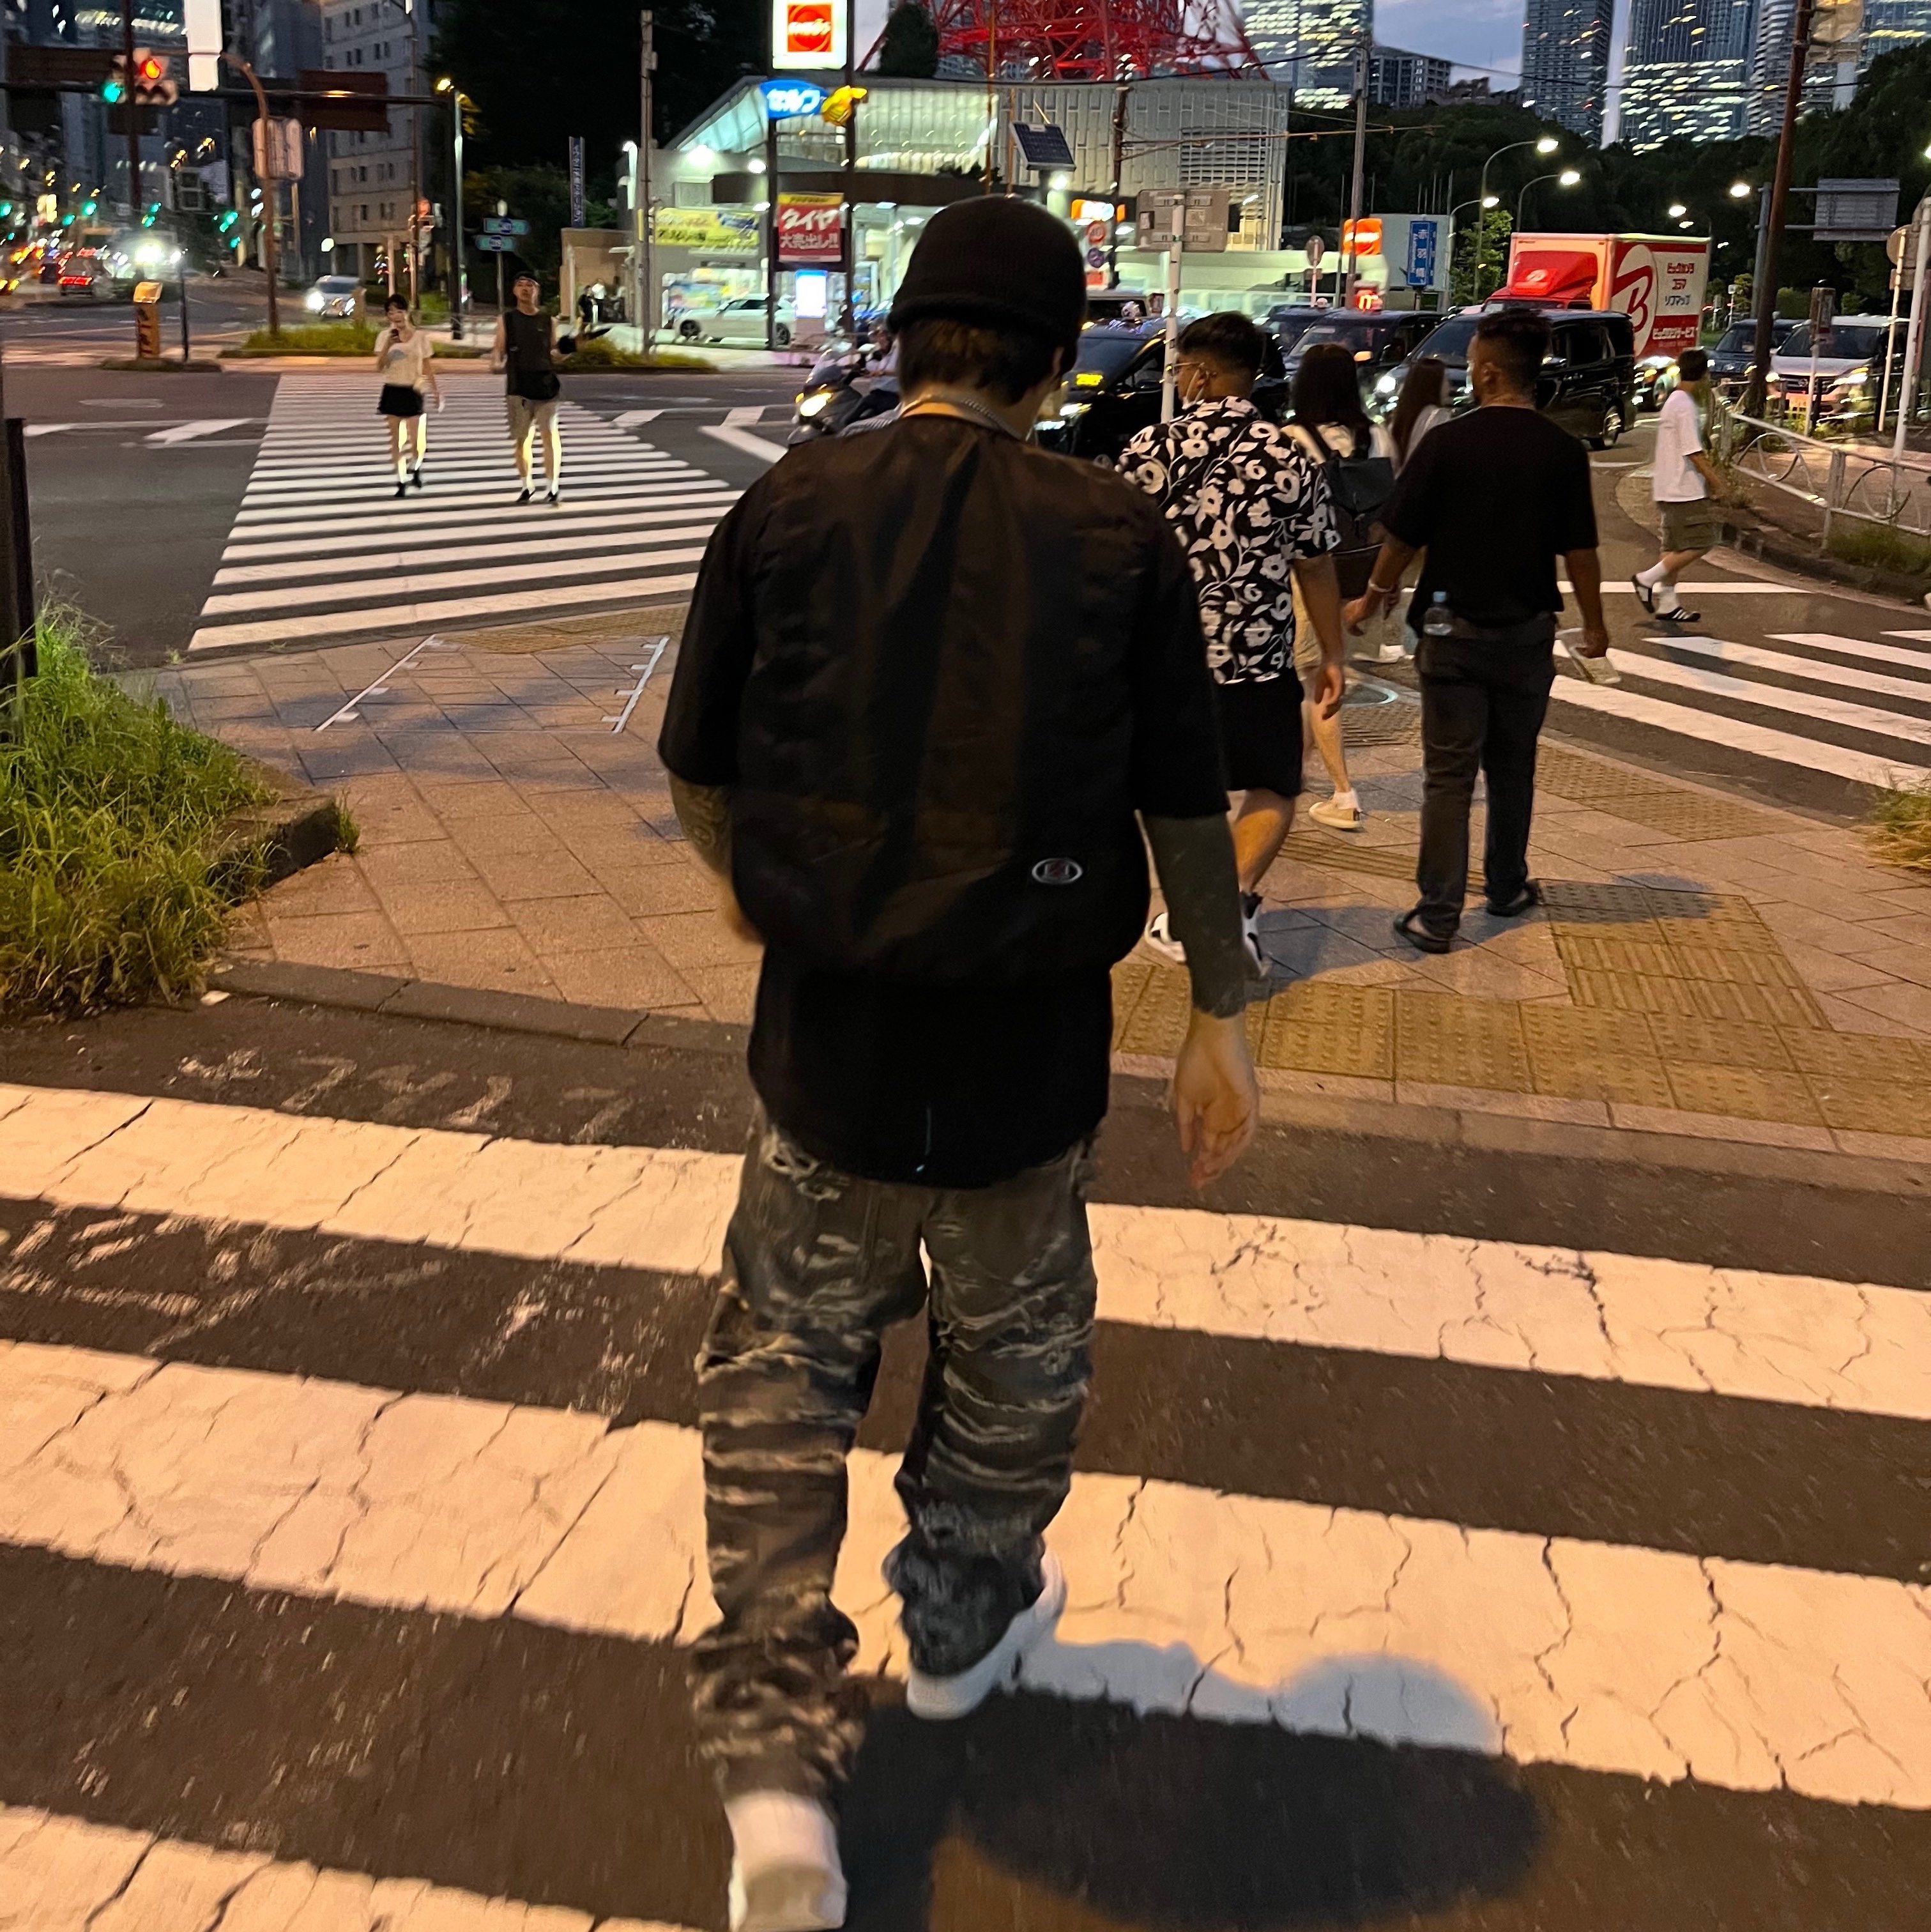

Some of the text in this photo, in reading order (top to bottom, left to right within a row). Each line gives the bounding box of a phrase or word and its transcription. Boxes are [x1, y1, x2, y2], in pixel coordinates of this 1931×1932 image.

[767, 89, 821, 113] セルフ
[781, 208, 839, 231] タイヤ
